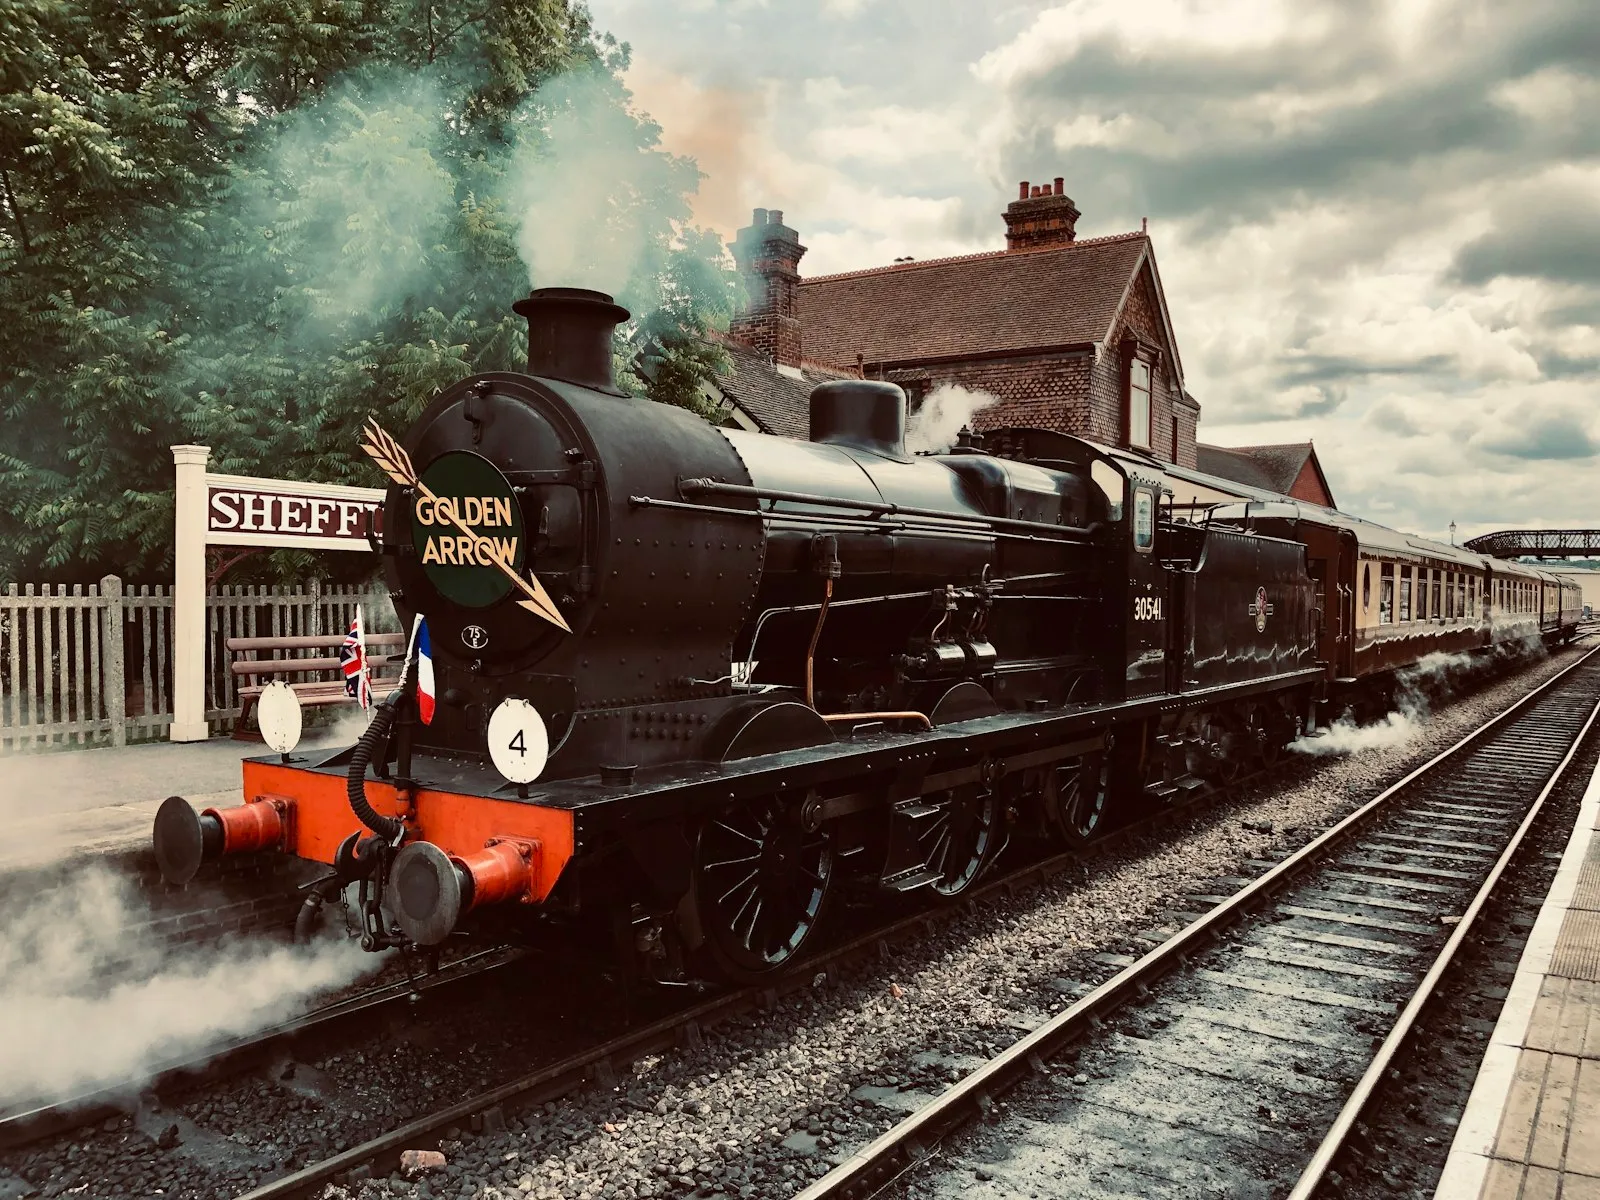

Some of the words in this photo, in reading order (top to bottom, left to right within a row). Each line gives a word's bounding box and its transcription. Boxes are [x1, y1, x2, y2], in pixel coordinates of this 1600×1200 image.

[415, 496, 513, 527] GOLDEN
[421, 535, 518, 567] ARROW
[1134, 596, 1162, 621] 30541
[468, 627, 481, 639] 75
[472, 637, 478, 648] E
[508, 729, 528, 758] 4
